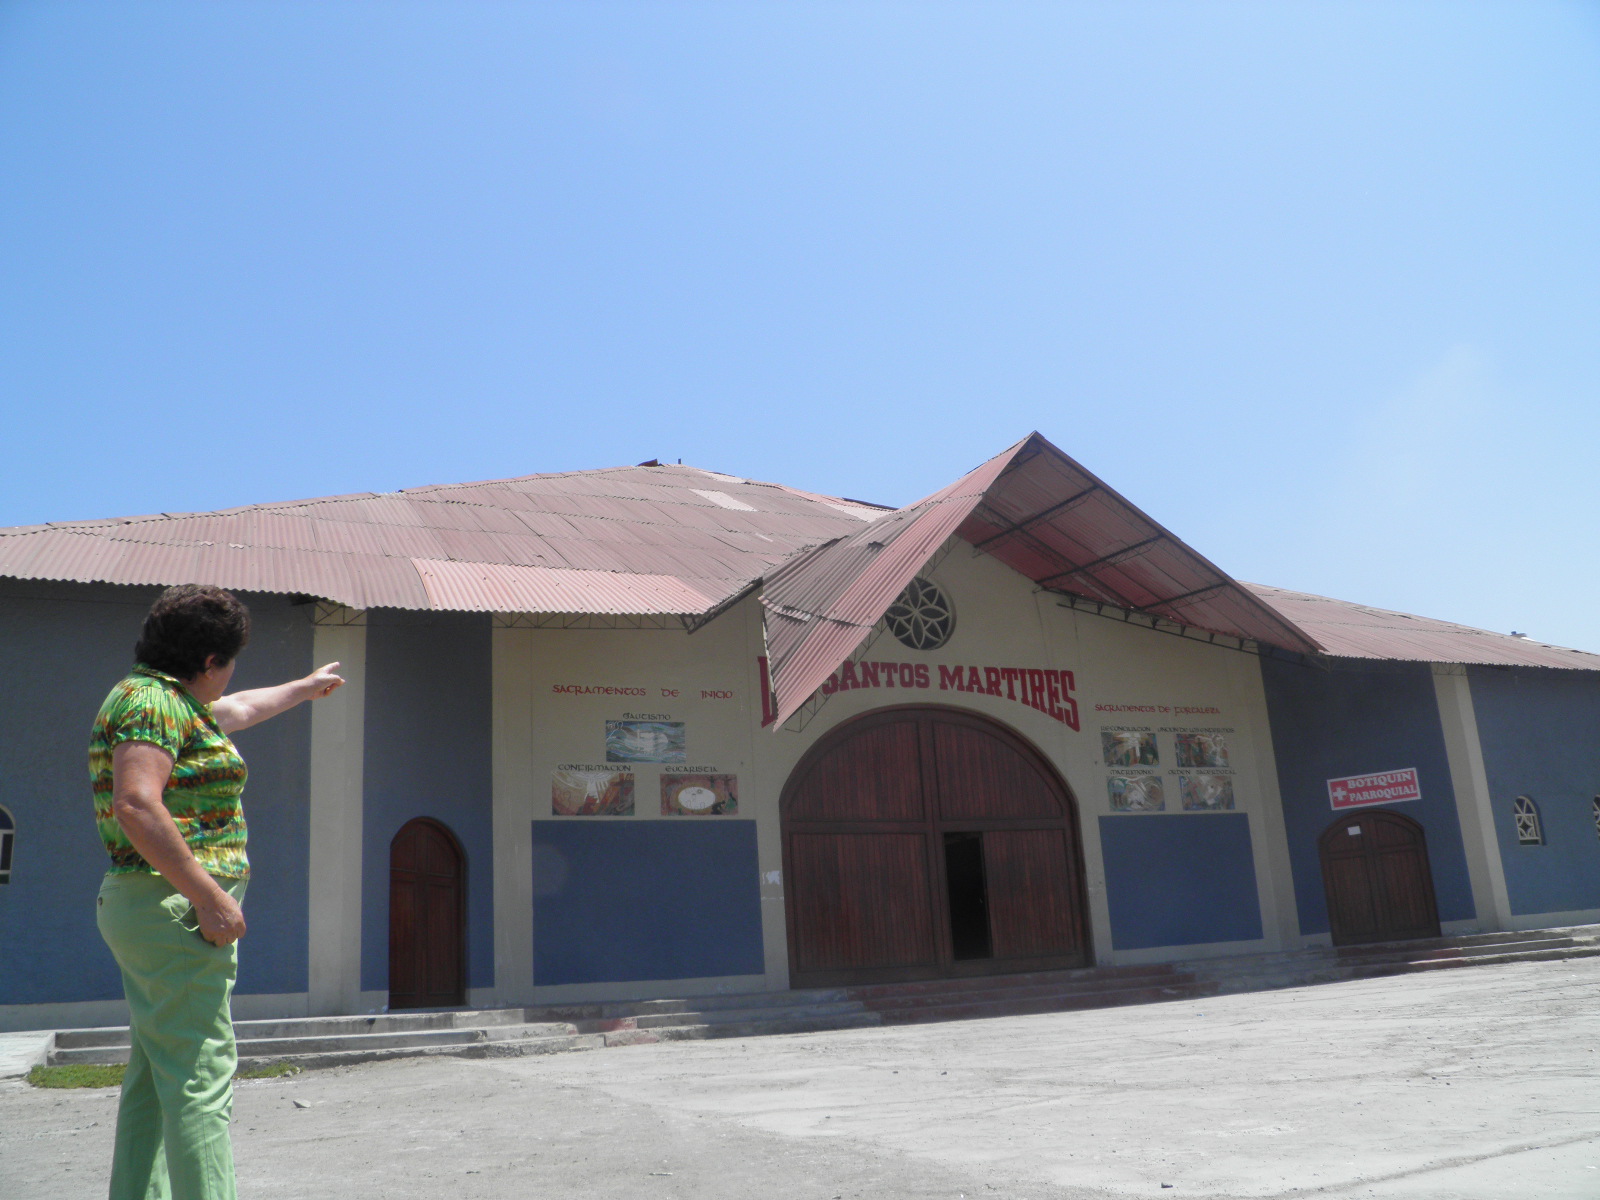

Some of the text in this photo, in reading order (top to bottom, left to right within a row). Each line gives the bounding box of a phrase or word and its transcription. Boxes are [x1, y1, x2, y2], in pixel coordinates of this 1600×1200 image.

[552, 684, 733, 699] SACRAMENTOS DE INICIO
[821, 661, 931, 694] SANTOS
[938, 664, 1081, 733] MARTIRES
[1095, 704, 1221, 717] SACRAMENTOS DE FORTALEZA
[558, 764, 631, 772] CONFIRMACION
[665, 765, 718, 773] EUCARISTIA
[1347, 772, 1412, 789] BOTIQUIN
[1349, 785, 1417, 802] PARROQUIAL
